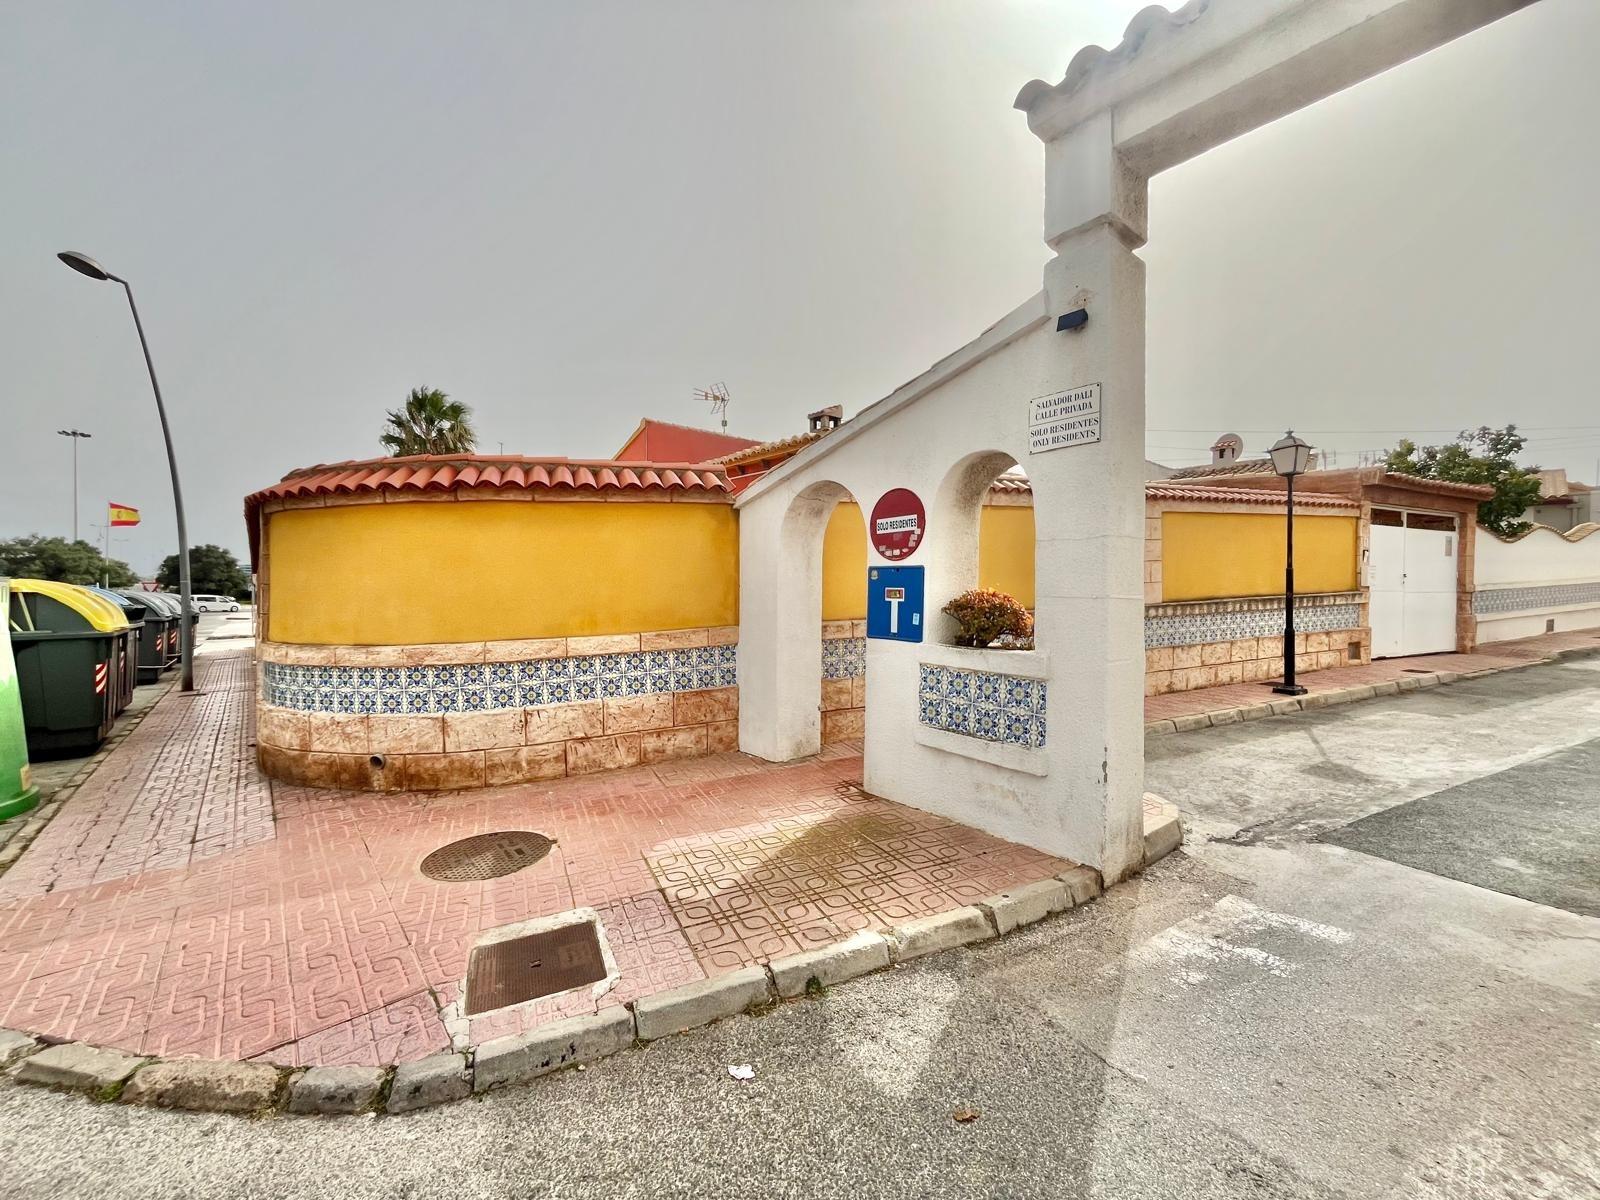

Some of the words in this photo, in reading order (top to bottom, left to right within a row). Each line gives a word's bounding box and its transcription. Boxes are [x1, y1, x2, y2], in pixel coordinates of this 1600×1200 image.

[1035, 408, 1058, 421] CALLE
[1060, 401, 1092, 415] PRIVADA
[1036, 394, 1072, 409] SALVADOR
[1030, 427, 1048, 438] SOLO
[1050, 417, 1099, 434] RESIDENTES
[1033, 437, 1049, 448] ONLY
[1052, 429, 1095, 444] RESIDENTS
[877, 521, 888, 531] SOLO
[890, 518, 916, 530] RESIDENTES
